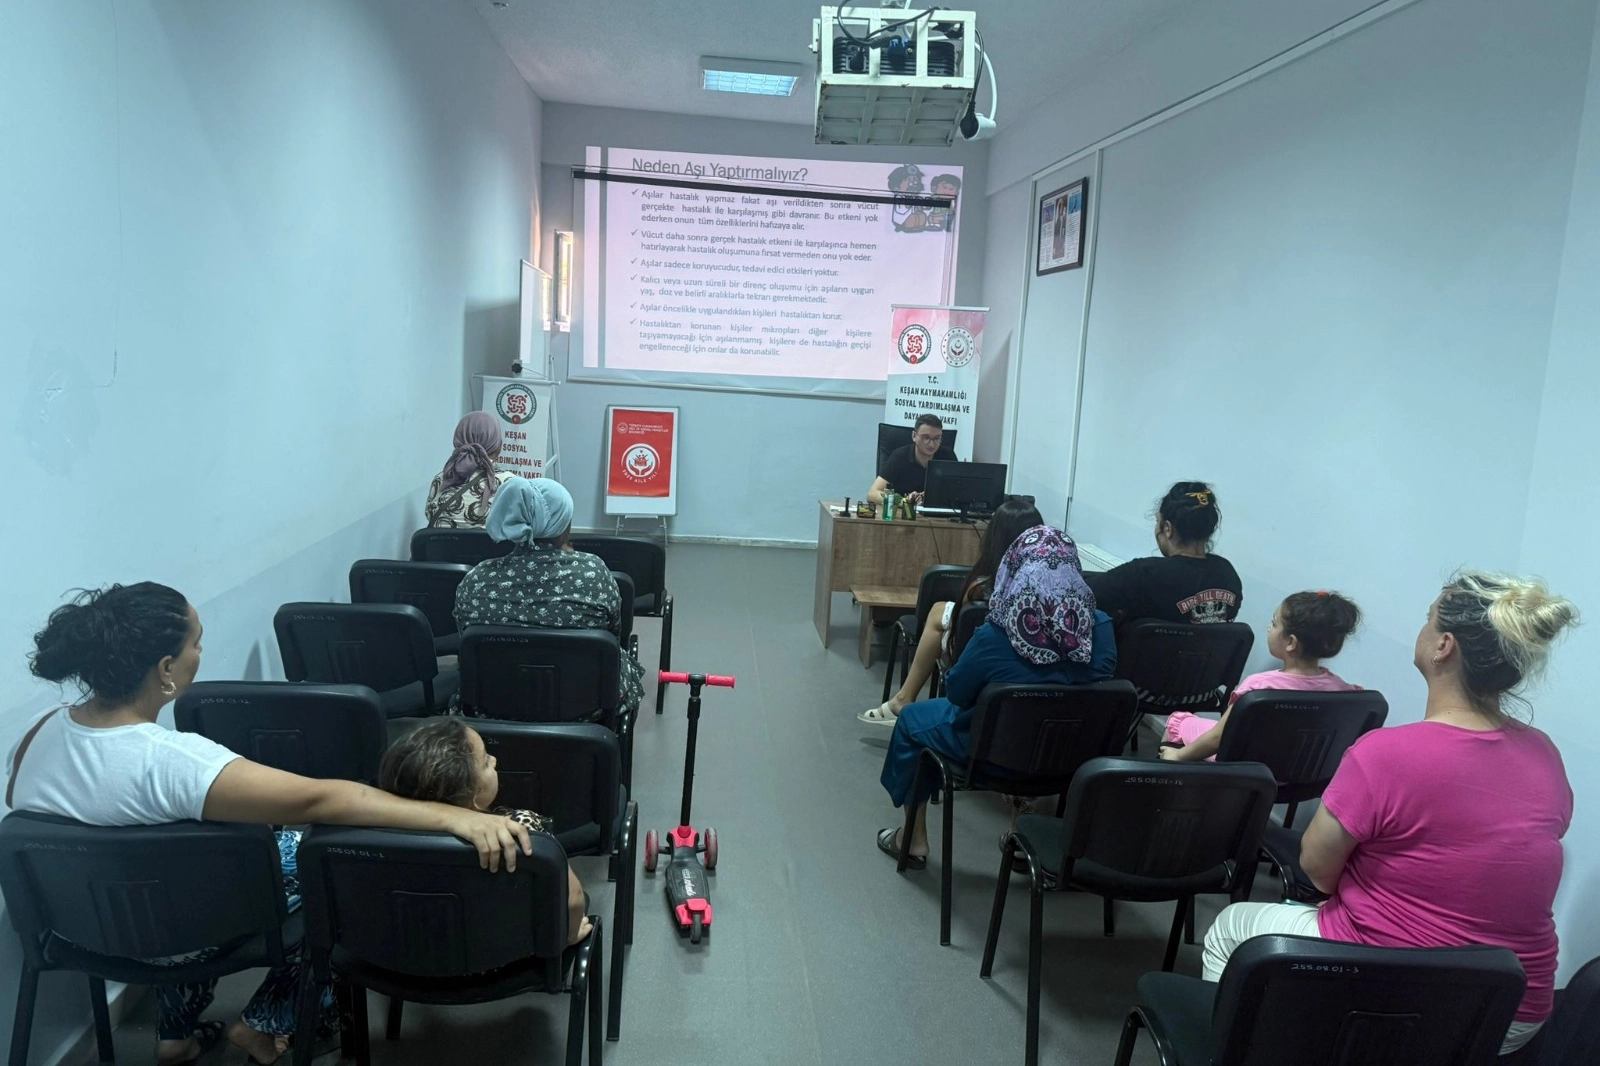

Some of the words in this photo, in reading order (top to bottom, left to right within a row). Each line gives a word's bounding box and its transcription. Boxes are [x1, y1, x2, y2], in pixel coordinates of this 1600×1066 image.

[632, 157, 680, 174] Neden
[685, 161, 705, 179] Aşı
[709, 162, 808, 183] Yaptırmalıyız?
[641, 189, 664, 199] Aşılar
[670, 191, 699, 201] hastalık
[705, 195, 735, 204] yapmaz
[741, 196, 760, 204] fakat
[783, 199, 824, 208] verildikten
[857, 202, 879, 210] vücut
[641, 203, 675, 212] gerçekte
[682, 204, 711, 214] hastalık
[714, 206, 724, 214] ile
[727, 207, 768, 218] karşılaşmış
[771, 210, 786, 220] gibi
[789, 211, 820, 219] davranır.
[838, 213, 861, 221] etkeni
[865, 214, 878, 223] yok
[641, 214, 673, 223] ederken
[698, 217, 714, 226] tüm
[715, 218, 759, 228] özelliklerini
[760, 220, 790, 230] hafızaya
[641, 230, 664, 239] Vücut
[665, 232, 685, 241] daha
[710, 236, 736, 245] gerçek
[737, 236, 766, 245] hastalık
[769, 237, 792, 246] etkeni
[794, 238, 803, 247] ile
[805, 239, 848, 250] karşılaşınca
[850, 241, 876, 250] hemen
[640, 242, 685, 253] hatırlayarak
[687, 245, 716, 254] hastalık
[718, 246, 760, 256] oluşumuna
[761, 248, 780, 257] fırsat
[782, 250, 821, 259] vermeden
[839, 252, 852, 262] yok
[854, 253, 872, 261] eder.
[640, 259, 662, 268] Aşılar
[663, 260, 691, 269] sadece
[692, 261, 741, 273] koruyucudur,
[742, 264, 765, 273] tedavi
[767, 266, 785, 274] edici
[786, 267, 813, 275] etkileri
[814, 268, 839, 277] yoktur.
[640, 275, 660, 284] Kalıcı
[663, 278, 681, 286] veya
[705, 279, 726, 288] süreli
[729, 280, 740, 288] bir
[742, 280, 766, 290] direnç
[769, 282, 802, 291] oluşumu
[804, 284, 818, 292] için
[821, 285, 848, 294] aşıların
[851, 286, 874, 295] uygun
[640, 288, 655, 297] yaş,
[658, 288, 672, 296] doz
[685, 288, 706, 297] belirli
[708, 290, 745, 299] aralıklarla
[746, 292, 771, 300] tekrarı
[772, 294, 827, 304] gerekmektedir.
[639, 303, 662, 312] Aşılar
[663, 304, 697, 313] öncelikle
[698, 306, 750, 316] uygulandıkları
[752, 308, 777, 318] kişileri
[780, 310, 820, 319] hastalıktan
[822, 312, 843, 320] korur.
[640, 319, 681, 329] Hastalıktan
[690, 322, 721, 331] korunan
[730, 324, 752, 333] kişiler
[761, 325, 800, 335] mikropları
[808, 327, 828, 336] diğer
[846, 329, 872, 338] kişilere
[639, 331, 695, 342] taşıyamayacağı
[699, 334, 712, 343] için
[715, 335, 763, 345] aşılanmamış
[769, 337, 796, 346] kişilere
[812, 338, 847, 348] hastalığın
[850, 340, 872, 350] geçişi
[639, 342, 691, 353] engelleneceği
[693, 344, 706, 354] için
[707, 345, 727, 354] onlar
[729, 346, 738, 354] da
[740, 346, 780, 356] korunabilir.
[928, 376, 939, 384] T.C.
[900, 386, 919, 397] KEŞAN
[920, 387, 967, 400] KAYMAKAMLIĞI
[895, 398, 917, 408] SOSYAL
[918, 400, 961, 414] YARDIMLAŞMA
[963, 405, 970, 414] VE
[505, 431, 526, 440] KEŞAN
[503, 443, 527, 453] SOSYAL
[534, 459, 542, 467] VE
[1200, 591, 1213, 601] TILL
[1215, 590, 1234, 604] DEATH
